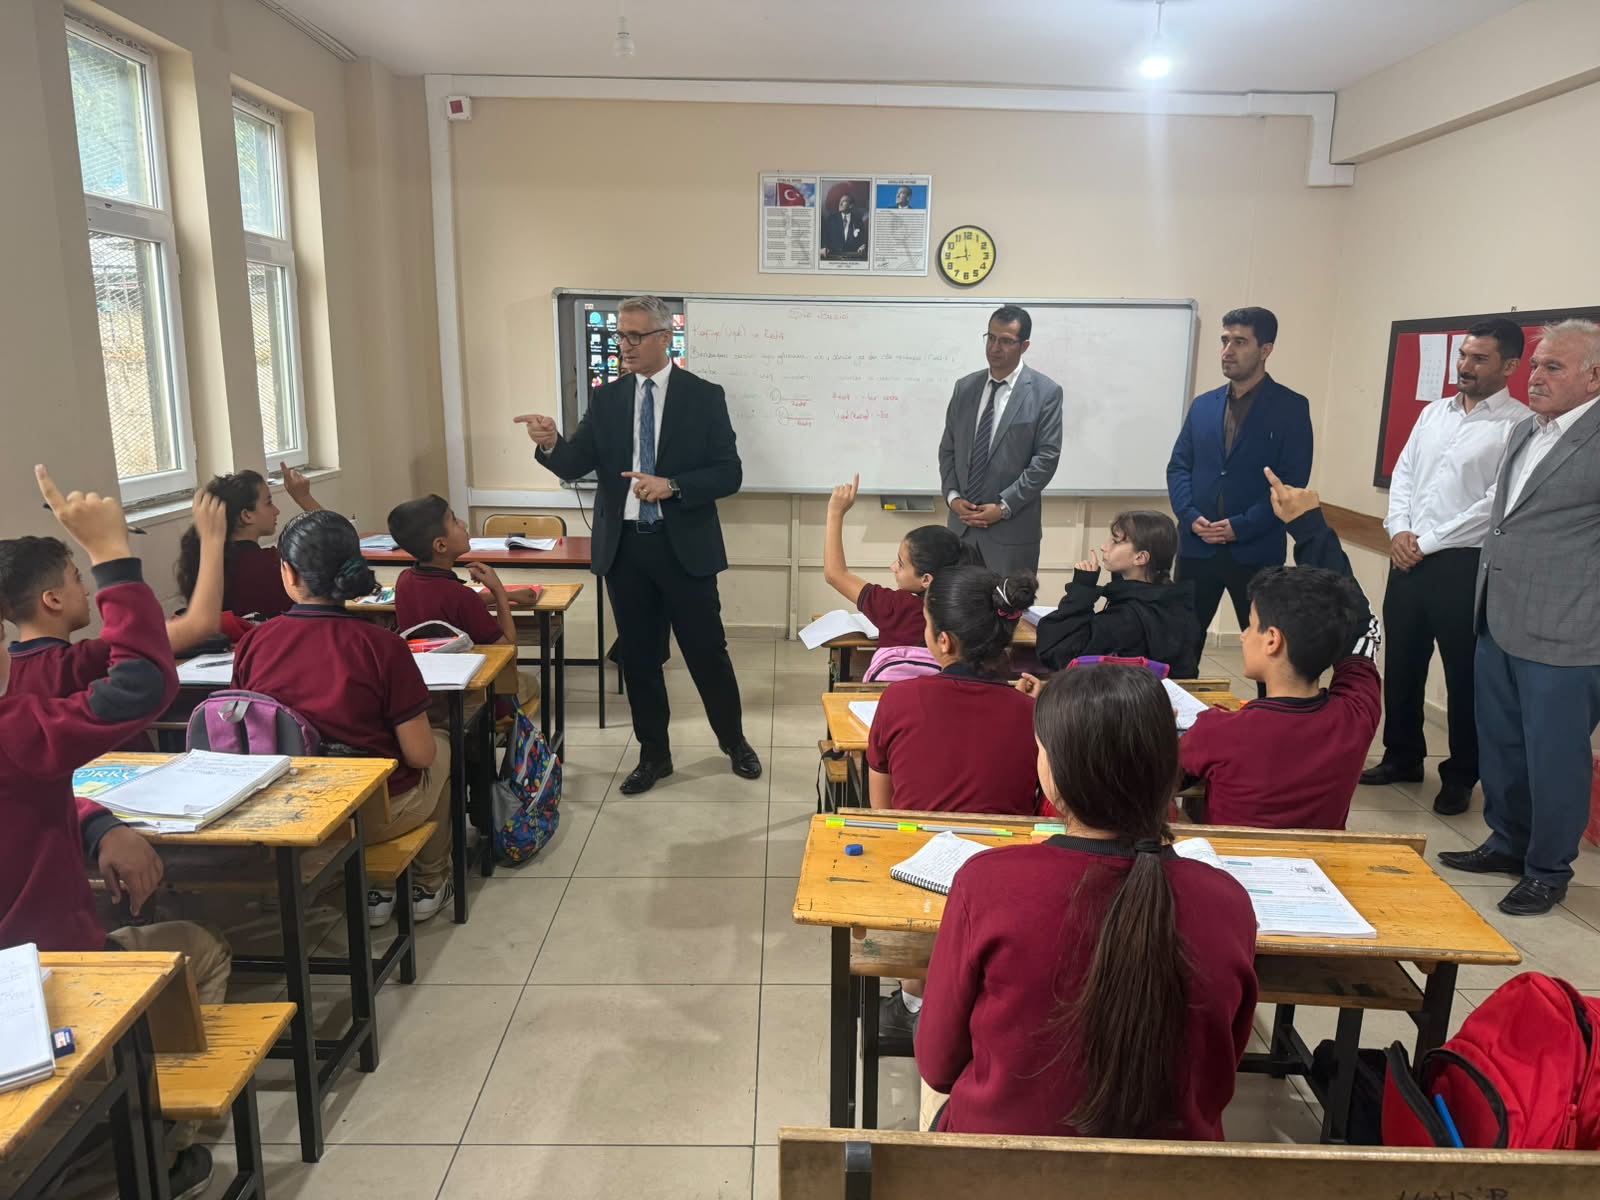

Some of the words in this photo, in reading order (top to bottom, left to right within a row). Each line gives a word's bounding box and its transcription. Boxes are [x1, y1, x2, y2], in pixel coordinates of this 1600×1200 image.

[964, 232, 972, 240] 12
[981, 242, 987, 250] 2
[983, 252, 989, 260] 3
[948, 262, 953, 270] 8
[980, 262, 986, 270] 4
[963, 272, 969, 280] 6
